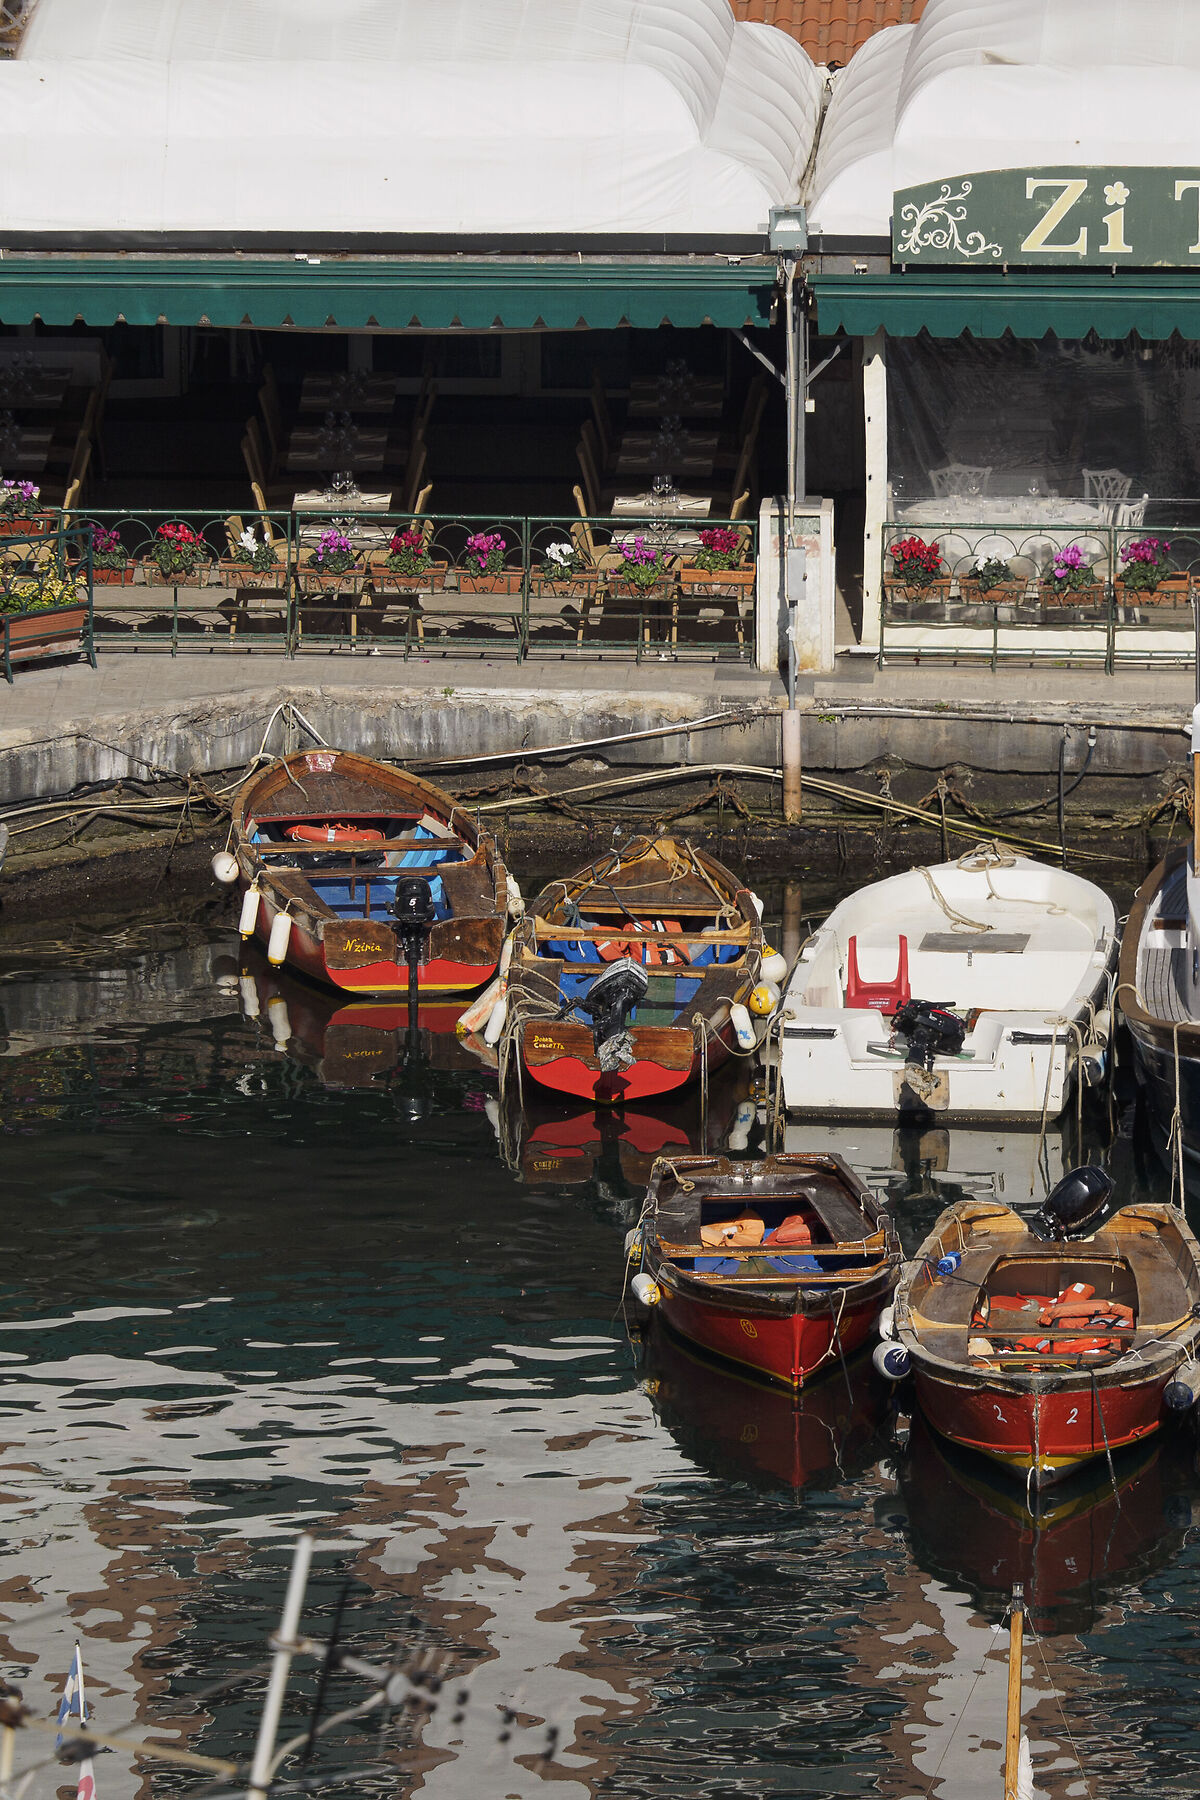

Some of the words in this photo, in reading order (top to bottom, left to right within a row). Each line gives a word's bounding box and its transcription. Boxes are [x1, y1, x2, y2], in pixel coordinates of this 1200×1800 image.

[1021, 178, 1133, 255] Zi
[408, 897, 417, 907] 5
[993, 1404, 1008, 1424] 2
[1066, 1407, 1078, 1425] 2
